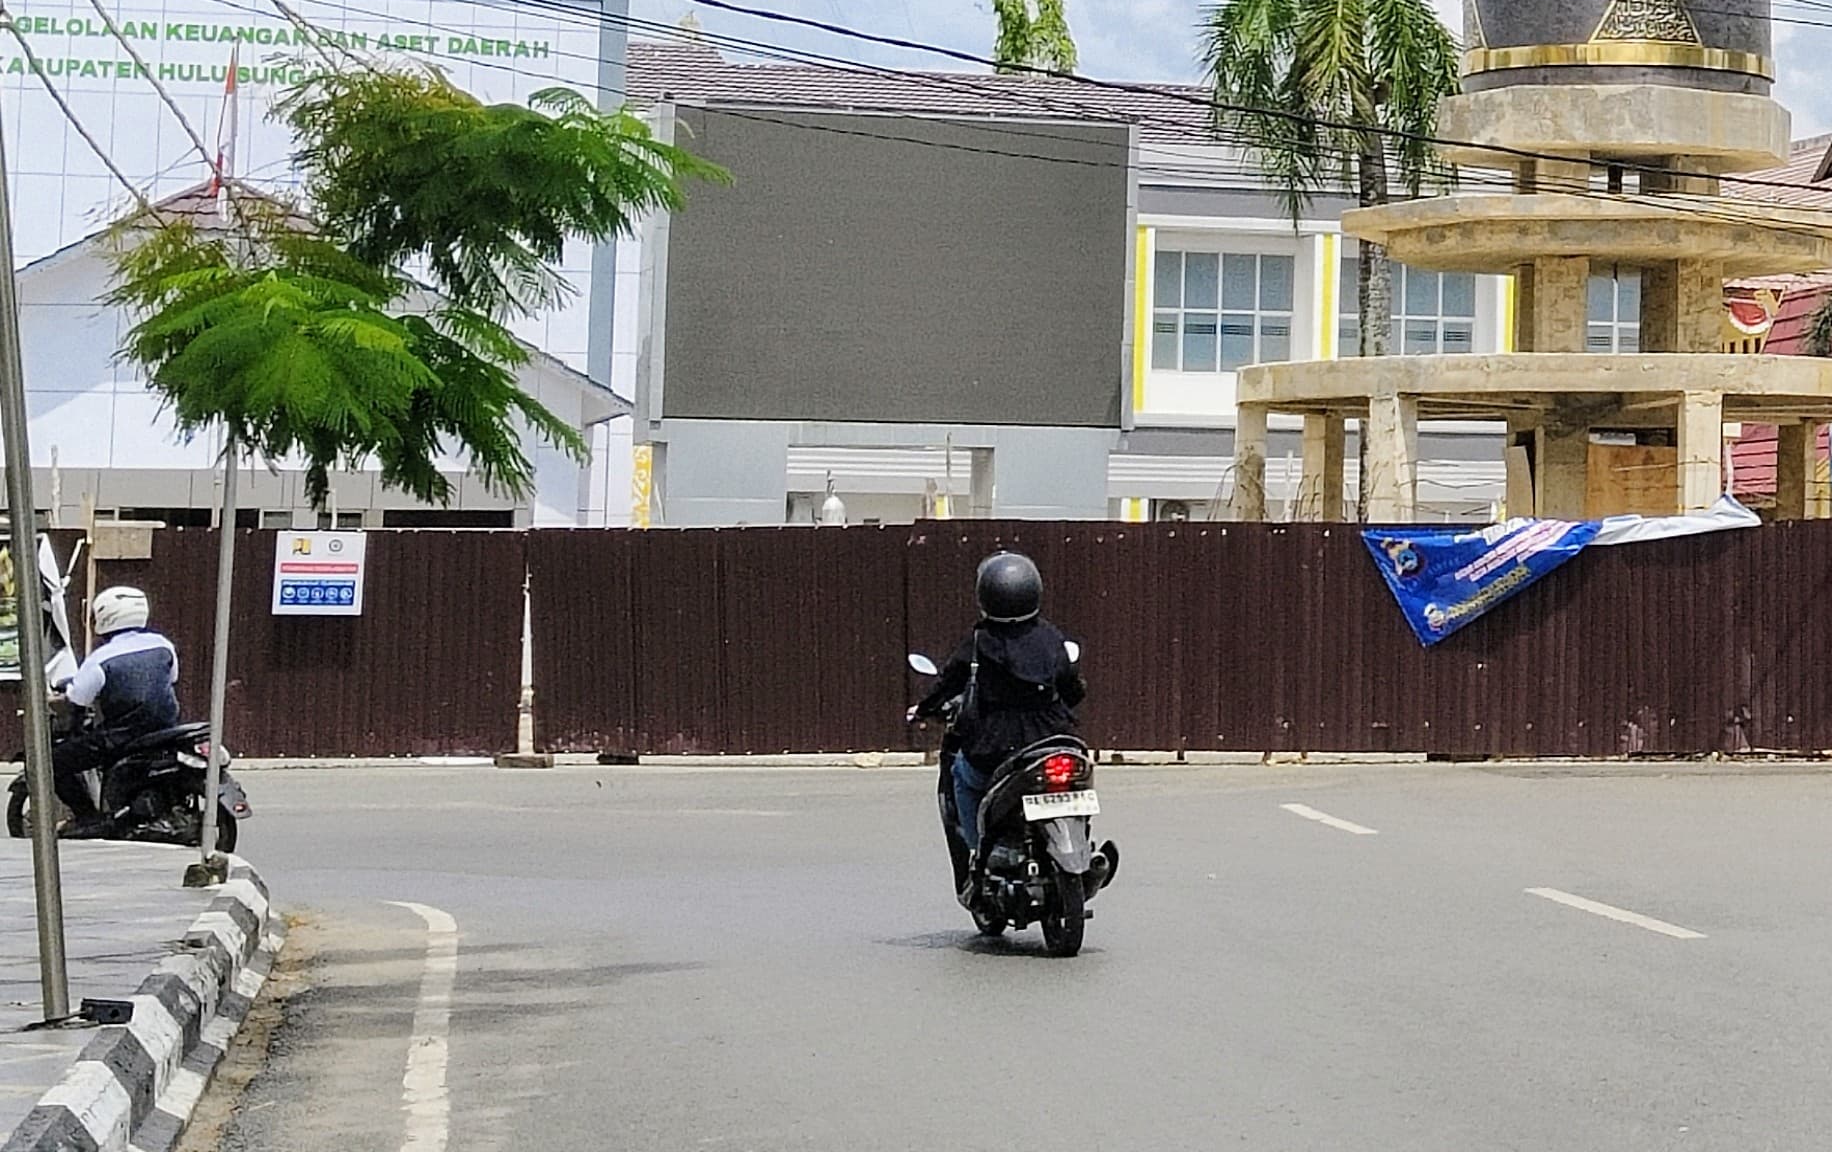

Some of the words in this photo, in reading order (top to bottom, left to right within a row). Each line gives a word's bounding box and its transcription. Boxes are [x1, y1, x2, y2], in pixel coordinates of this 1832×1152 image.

[376, 32, 441, 55] ASET
[451, 37, 550, 59] DAERAH
[159, 62, 228, 84] HULU
